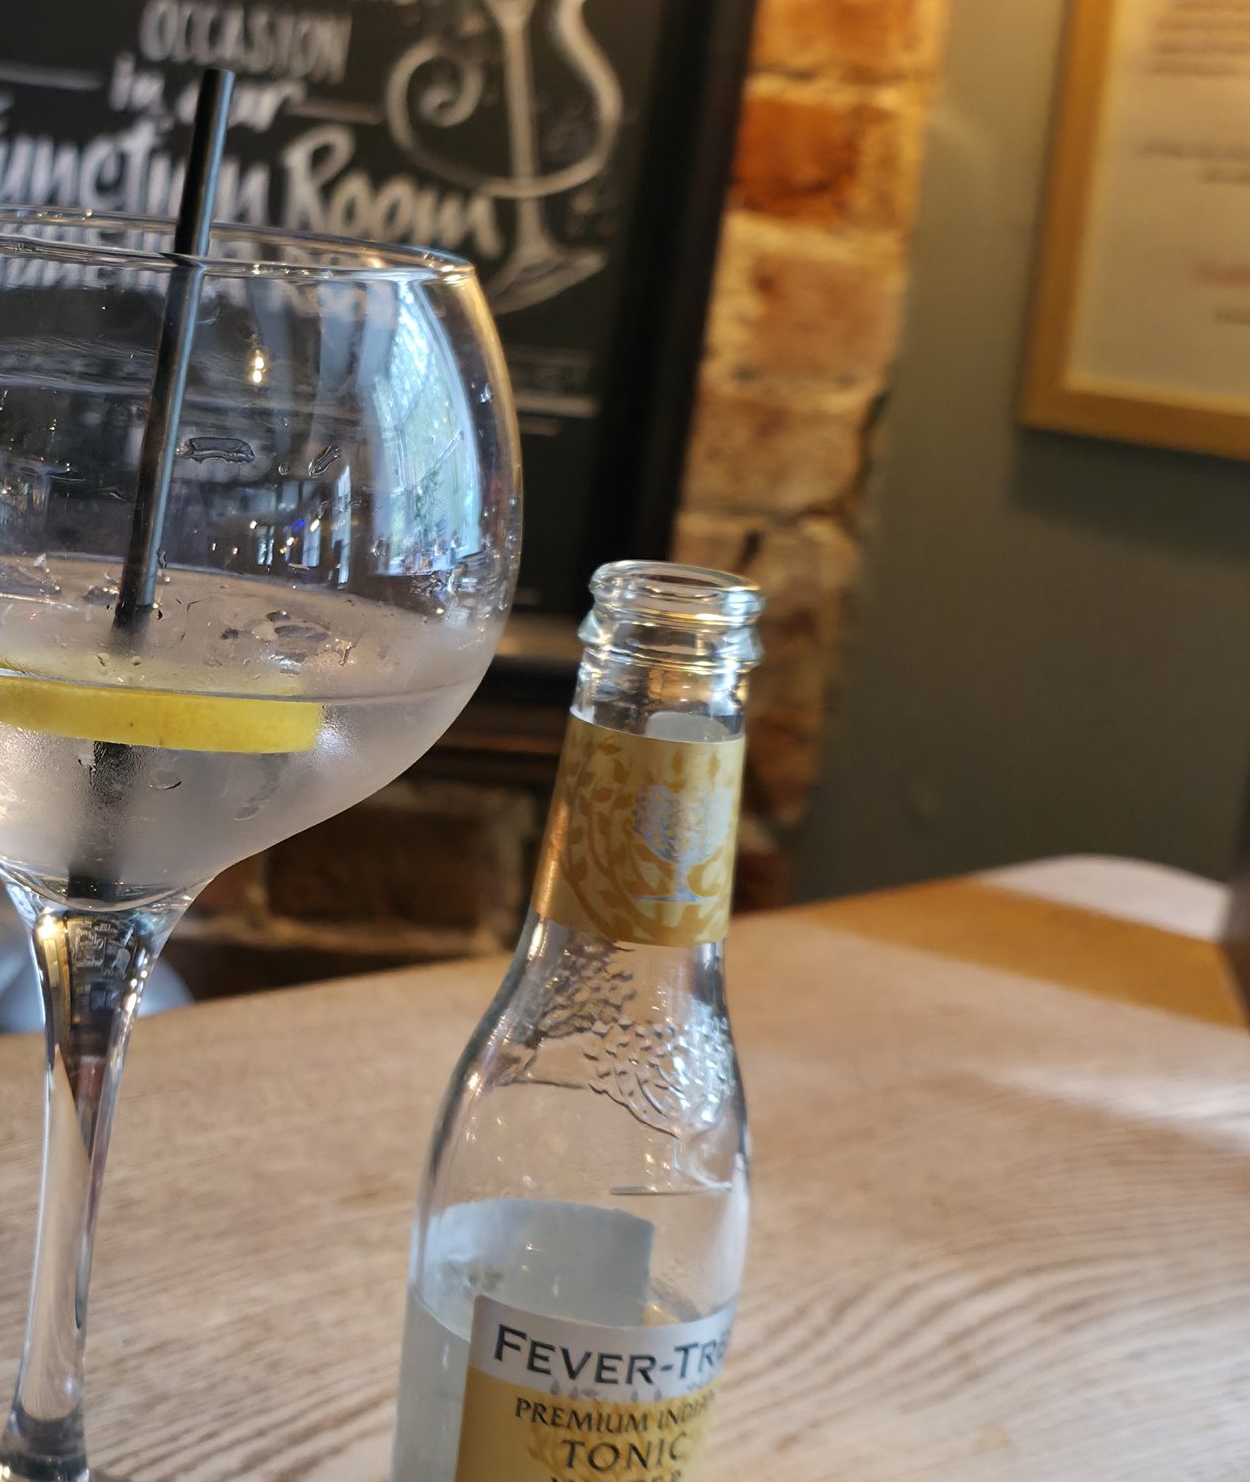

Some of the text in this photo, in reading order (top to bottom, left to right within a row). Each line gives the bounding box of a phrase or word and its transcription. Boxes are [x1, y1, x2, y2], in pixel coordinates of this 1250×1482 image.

[138, 0, 352, 85] OCCASION
[282, 122, 507, 260] Room
[515, 1396, 648, 1434] PREMIUM
[561, 1430, 688, 1472] TONIC
